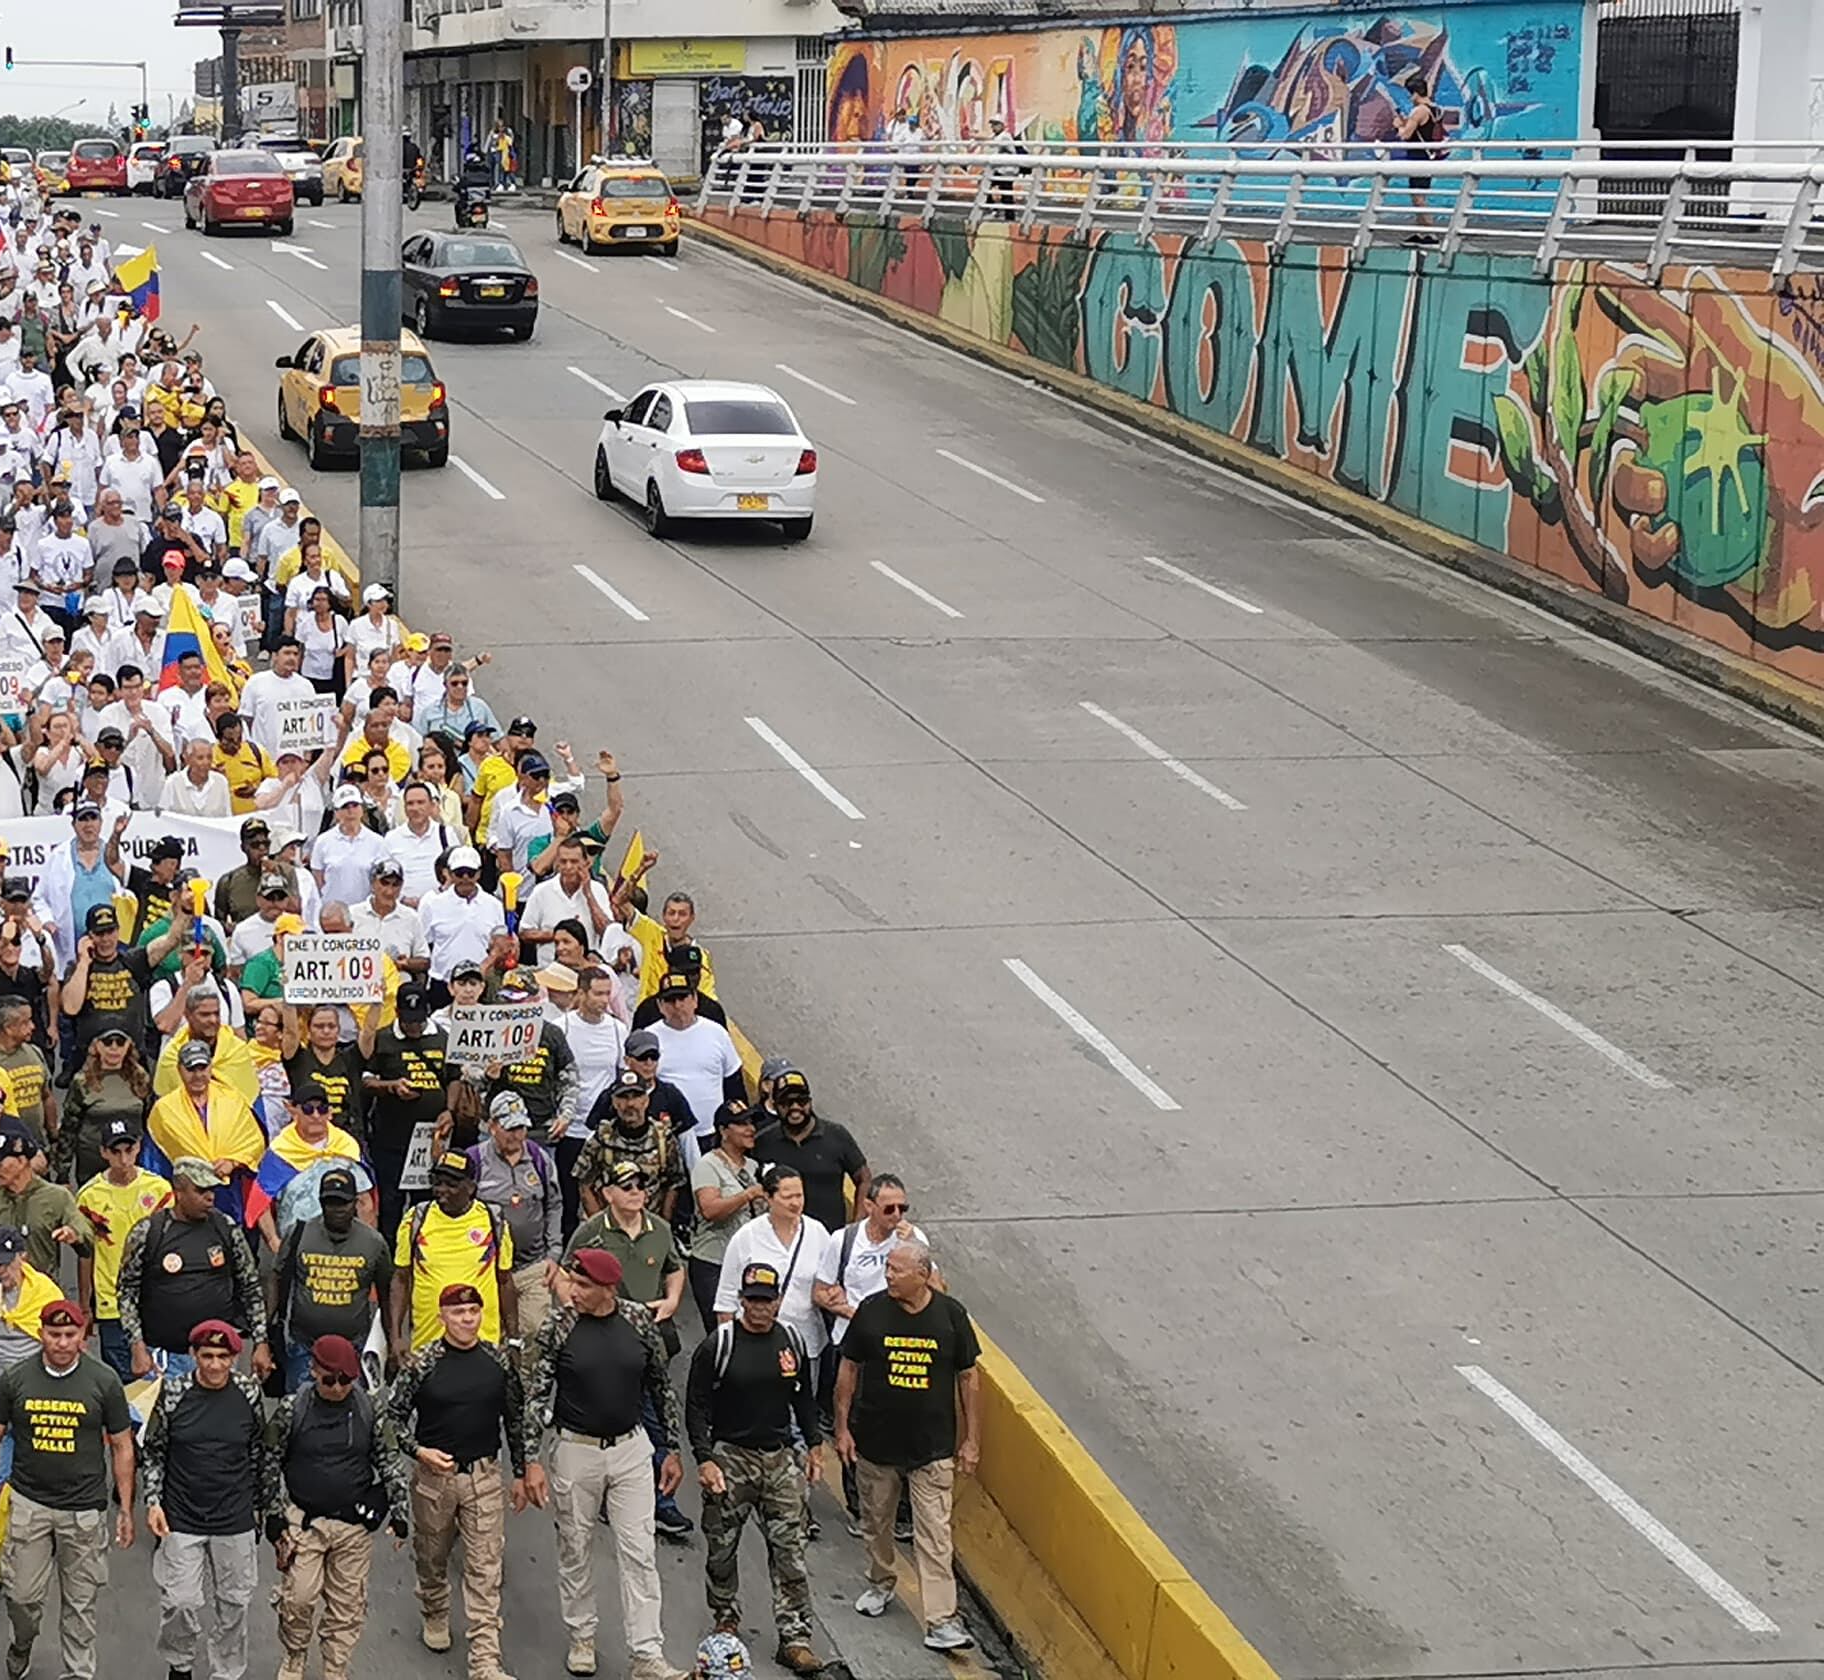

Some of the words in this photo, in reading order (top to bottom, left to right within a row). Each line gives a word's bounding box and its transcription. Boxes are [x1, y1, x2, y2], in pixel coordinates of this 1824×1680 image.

[1078, 230, 1552, 556] COME
[283, 717, 307, 734] ART.
[309, 712, 325, 731] 10
[287, 940, 308, 952] CNE
[312, 940, 318, 951] Y
[322, 938, 381, 952] CONGRESO
[294, 960, 333, 981] ART.
[337, 956, 373, 982] 109
[455, 1010, 475, 1021] CNE
[480, 1010, 487, 1021] Y
[489, 1006, 543, 1021] CONGRESO
[457, 1029, 496, 1048] ART.
[501, 1023, 535, 1048] 109
[309, 1266, 357, 1279] FUERZA
[312, 1291, 351, 1305] VALLE
[884, 1336, 938, 1350] RESERVA
[888, 1351, 933, 1363] ACTIVA
[888, 1375, 929, 1389] VALLE
[25, 1399, 87, 1414] RESERVA
[30, 1414, 80, 1427] ACTIVA
[32, 1437, 75, 1453] VALLE
